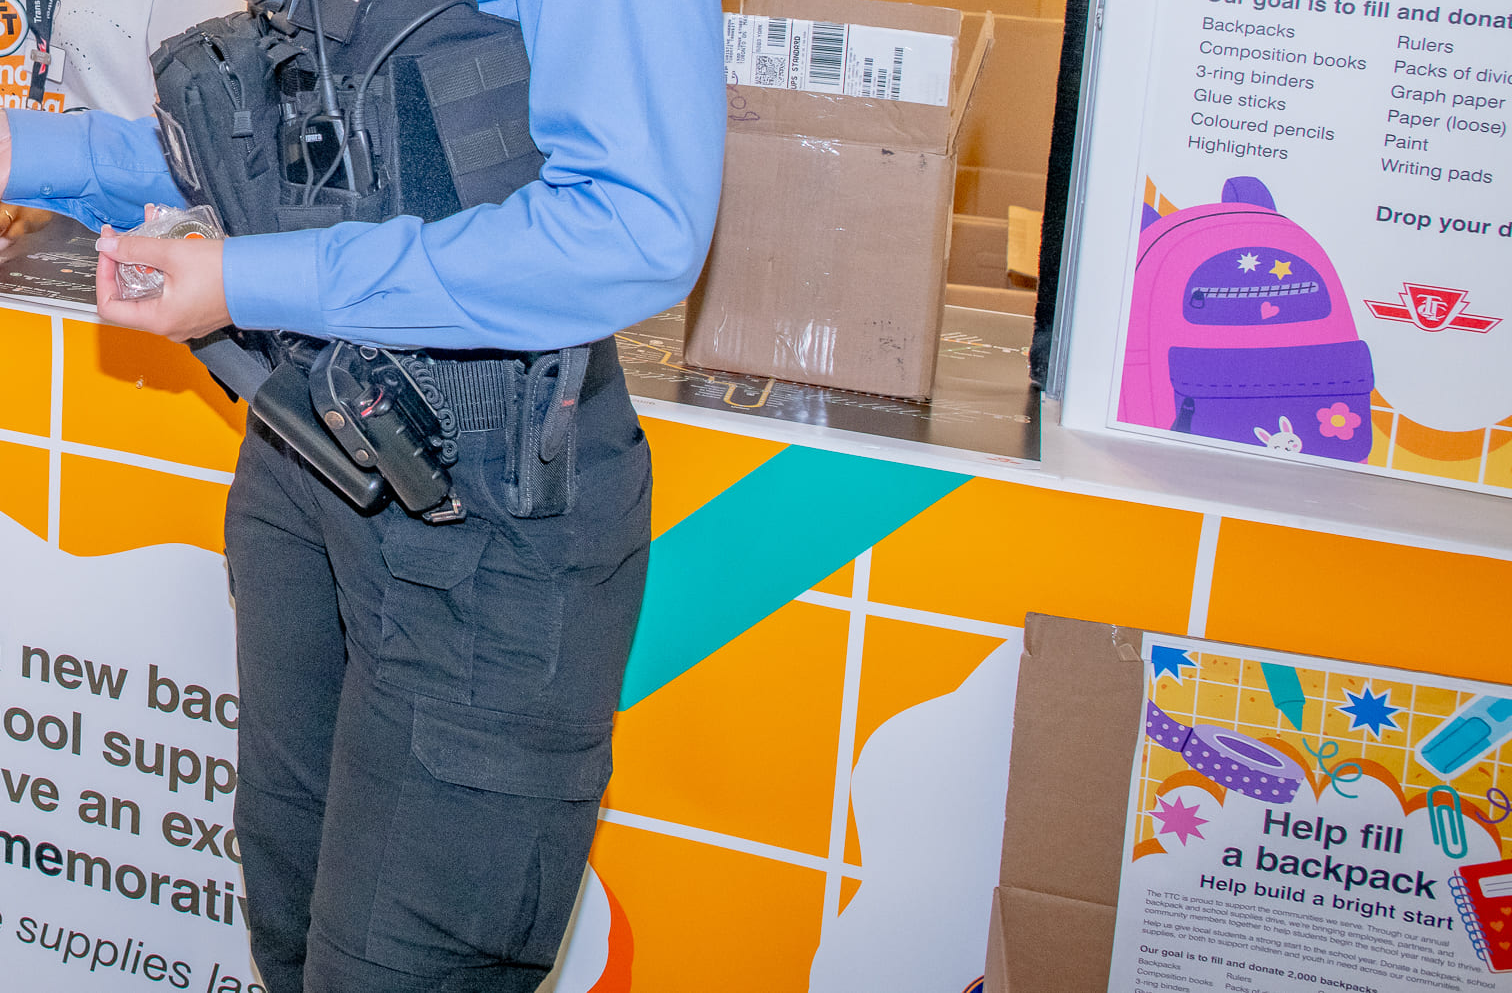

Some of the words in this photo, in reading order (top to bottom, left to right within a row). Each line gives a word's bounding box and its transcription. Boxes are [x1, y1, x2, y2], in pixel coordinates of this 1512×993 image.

[1362, 0, 1390, 19] fill
[1396, 5, 1440, 23] and
[1201, 16, 1296, 39] Backpacks
[791, 35, 801, 72] STANDARD
[1198, 40, 1308, 66] Composition
[1313, 51, 1368, 71] books
[1396, 34, 1455, 54] Rulers
[790, 75, 799, 90] UPS
[1195, 64, 1245, 86] 3-ring
[1250, 68, 1315, 90] binders
[1393, 59, 1448, 79] Packs
[1452, 65, 1472, 81] of
[1193, 88, 1234, 106] Glue
[1237, 91, 1287, 111] sticks
[1390, 84, 1446, 106] Graph
[1451, 93, 1507, 111] paper
[1190, 111, 1269, 134] Coloured
[1273, 120, 1336, 142] pencils
[1387, 109, 1440, 130] Paper
[1445, 115, 1508, 138] (loose)
[1187, 135, 1289, 161] Highlighters
[1384, 133, 1429, 152] Paint
[1380, 157, 1443, 181] Writing
[1447, 167, 1494, 184] pads
[1376, 205, 1432, 228] Drop
[1439, 216, 1492, 235] your
[21, 643, 129, 700] new
[147, 663, 239, 730] bac
[102, 728, 237, 803] supp
[78, 788, 141, 836] an
[1263, 807, 1347, 847] Help
[1360, 822, 1404, 854] fill
[1221, 845, 1243, 868] a
[1255, 845, 1438, 900] backpack
[1199, 873, 1247, 896] Help
[1253, 880, 1305, 903] build
[1312, 893, 1325, 907] a
[1332, 893, 1396, 919] bright
[1402, 910, 1455, 931] start
[15, 909, 193, 991] supplies
[1139, 944, 1159, 954] Our
[1161, 947, 1184, 959] goal
[1186, 951, 1195, 961] is
[1198, 954, 1208, 963] to
[1211, 956, 1223, 965] fill
[1226, 959, 1246, 969] and
[1248, 963, 1285, 977] donate
[1287, 970, 1317, 983] 2,000
